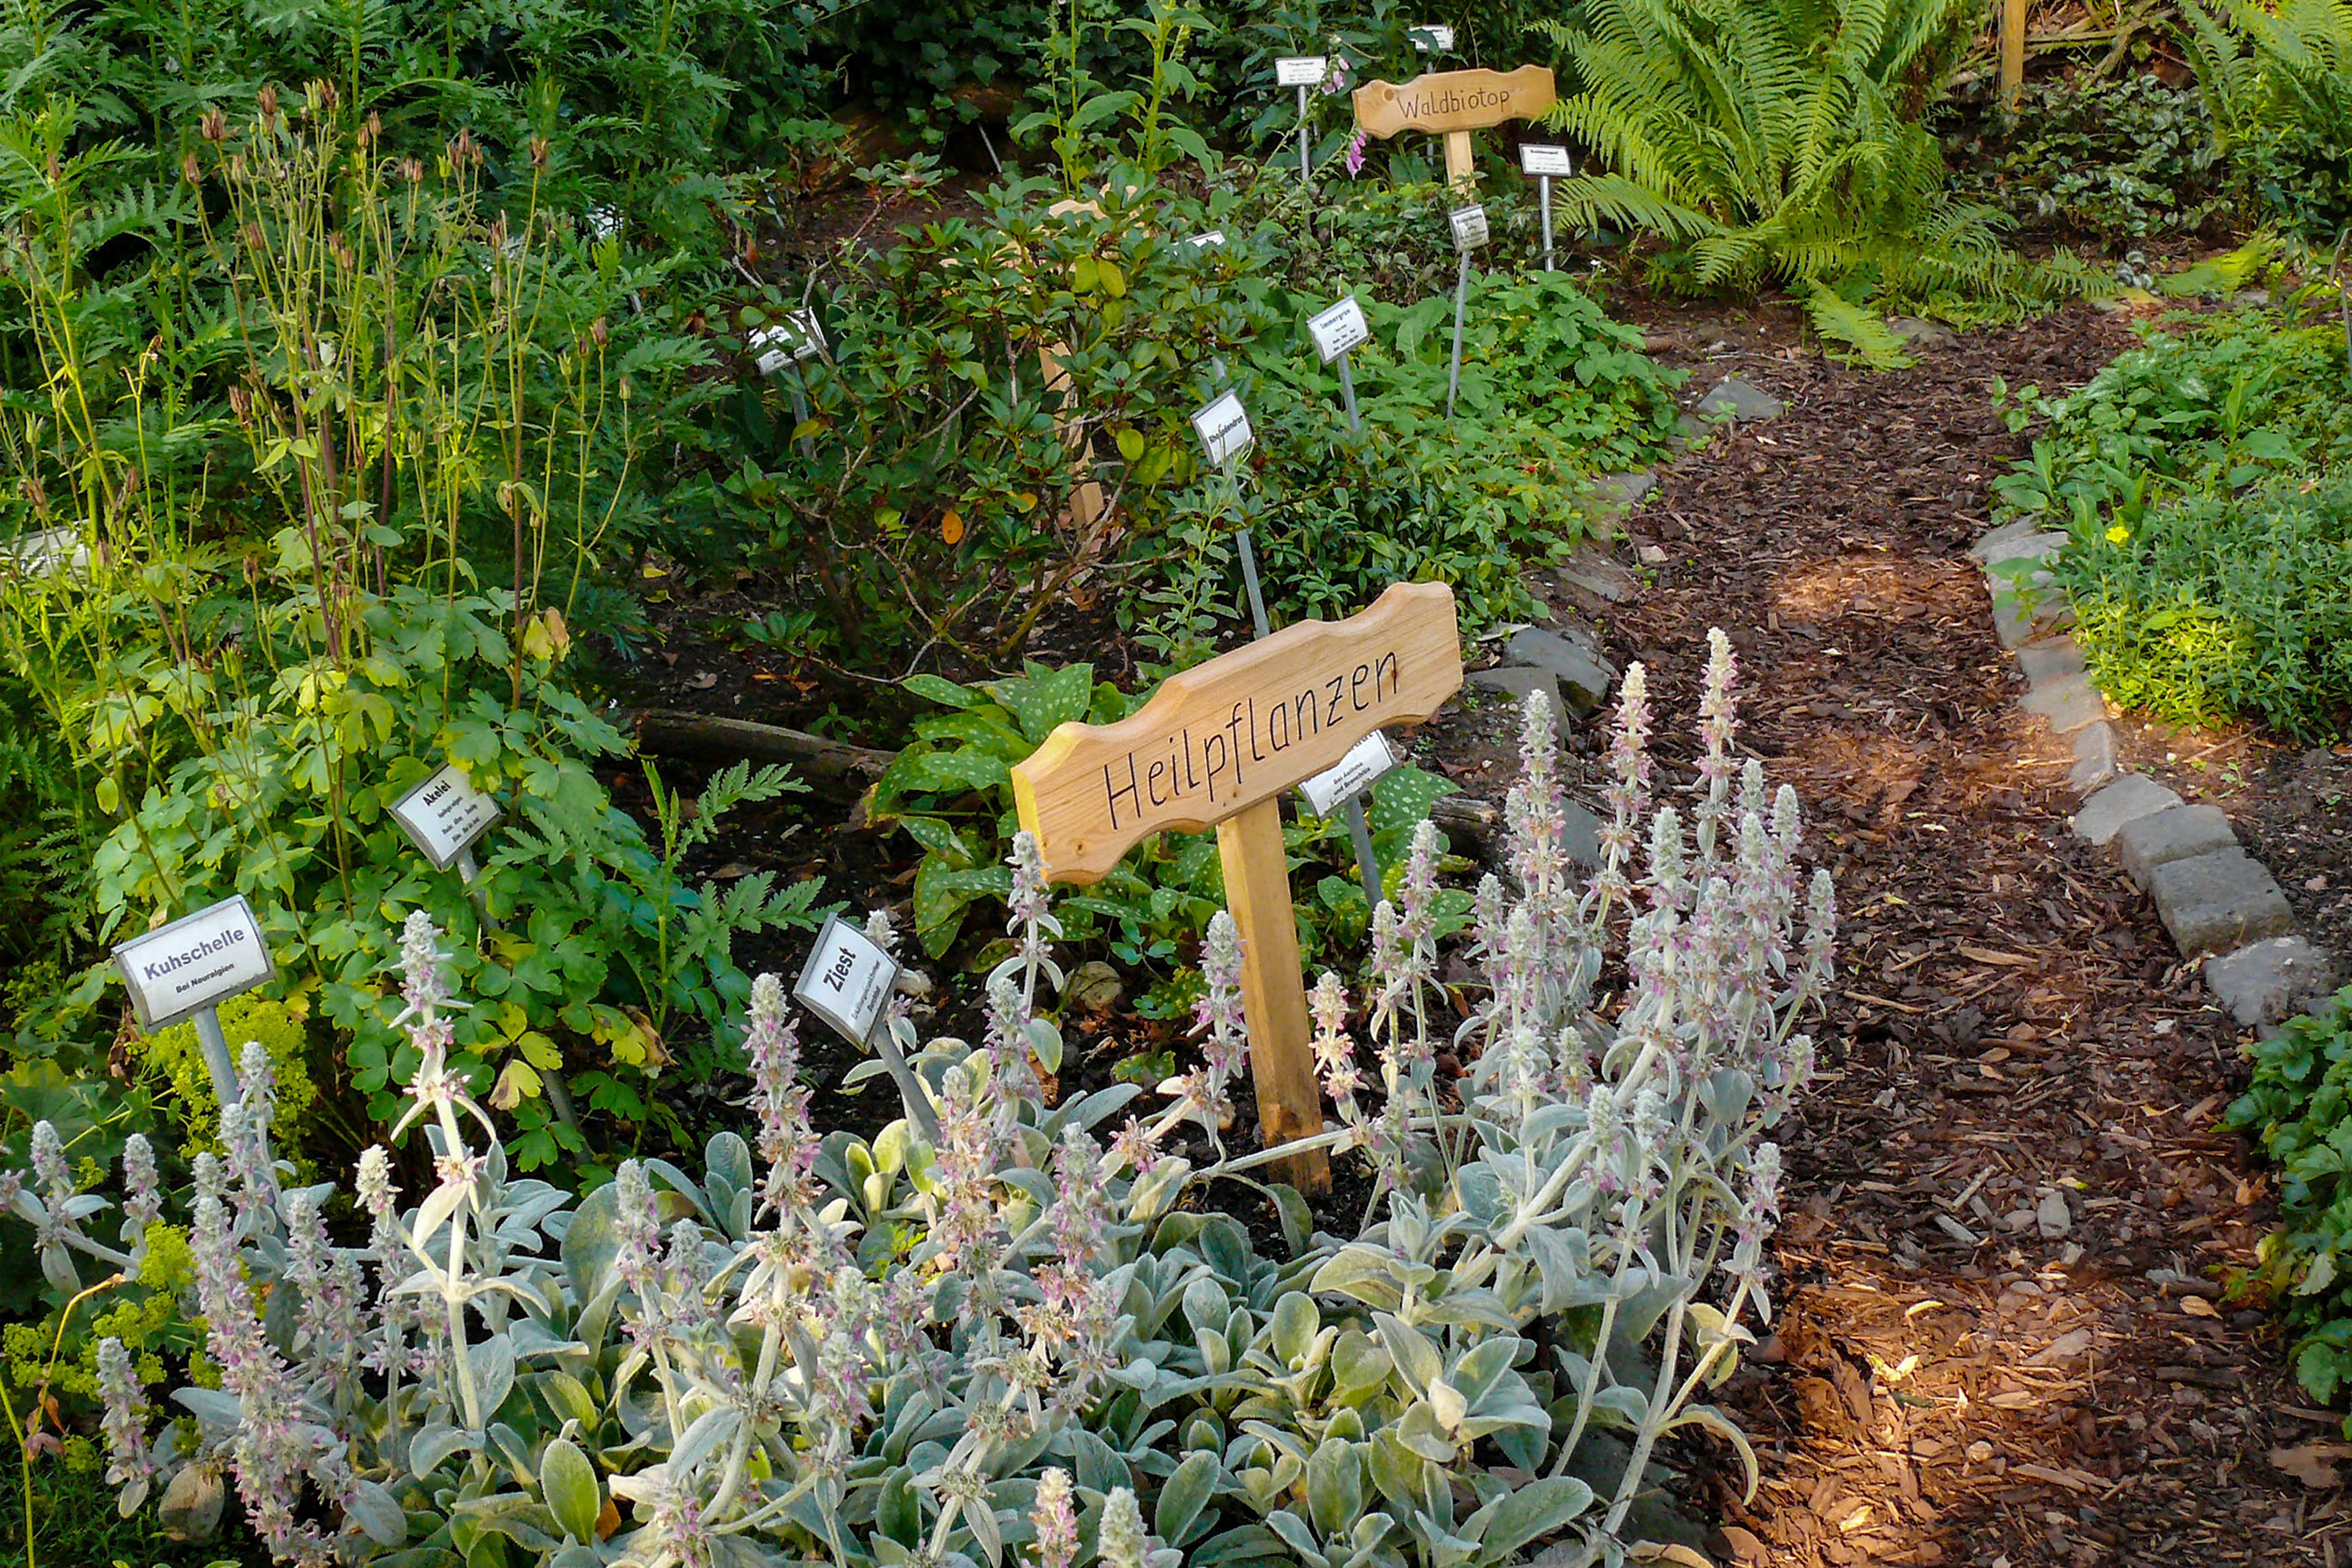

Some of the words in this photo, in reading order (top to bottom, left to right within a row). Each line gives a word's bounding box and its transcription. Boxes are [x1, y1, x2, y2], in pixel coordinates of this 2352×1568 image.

[1396, 87, 1510, 119] Waldbiotop
[1103, 651, 1399, 830] Heilpflanzen
[423, 779, 451, 806] Akelei
[144, 929, 245, 980] Kuhschelle
[823, 947, 856, 993] Ziest
[176, 983, 190, 994] Bei
[191, 963, 234, 987] Neuralgien
